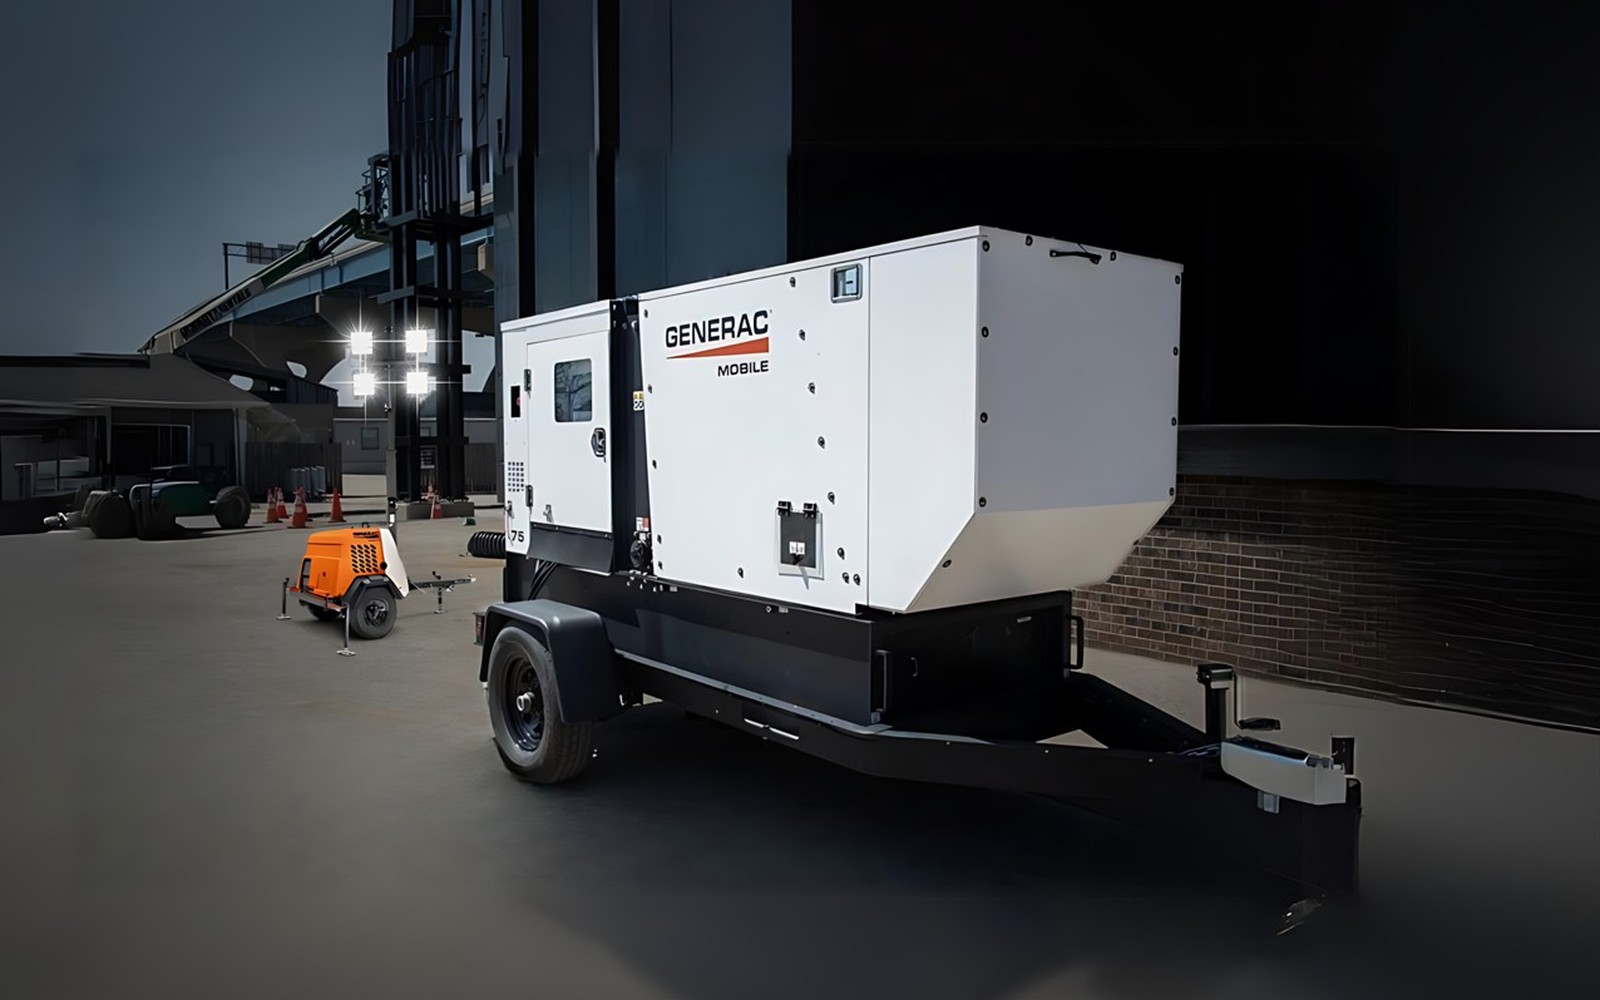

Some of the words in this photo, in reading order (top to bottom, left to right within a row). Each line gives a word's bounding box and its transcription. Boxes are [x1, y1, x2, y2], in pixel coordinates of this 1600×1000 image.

[665, 310, 769, 348] GENERAC
[717, 360, 769, 377] MOBILE
[511, 530, 525, 543] 75
